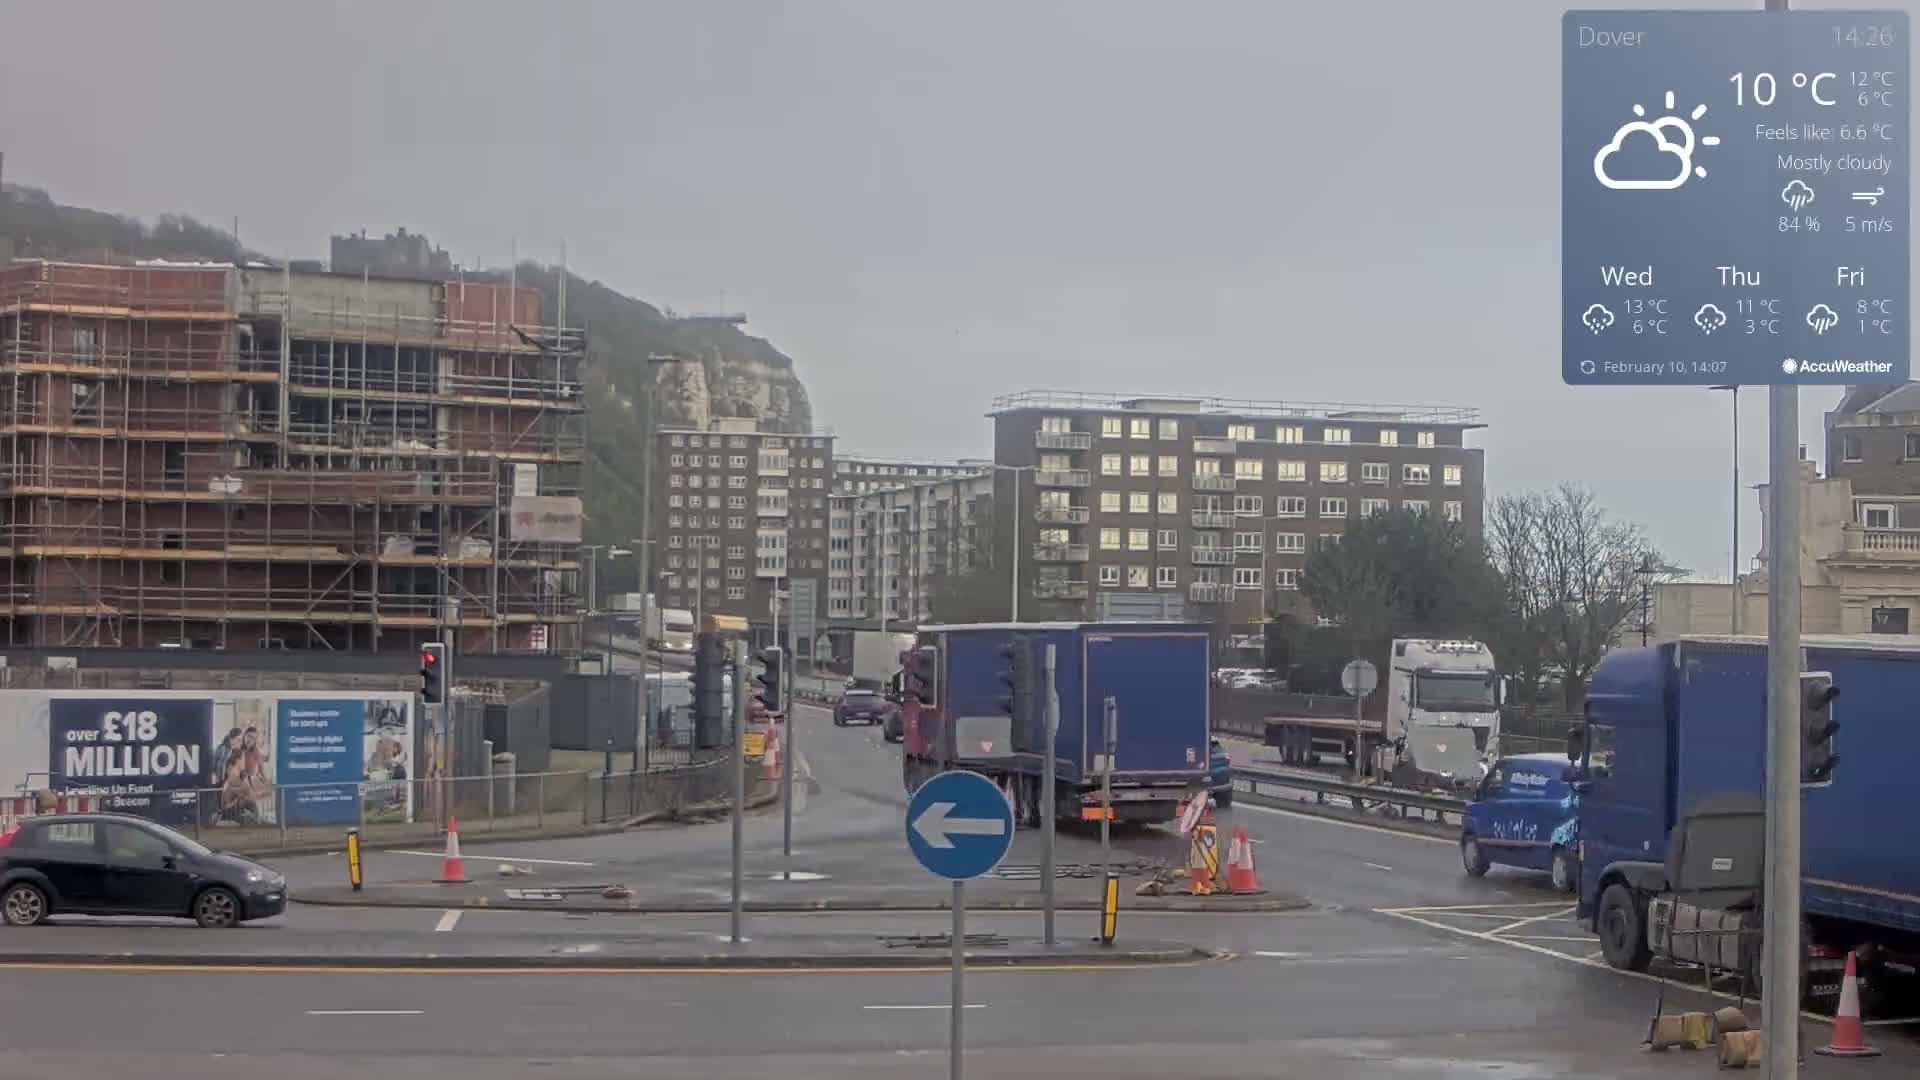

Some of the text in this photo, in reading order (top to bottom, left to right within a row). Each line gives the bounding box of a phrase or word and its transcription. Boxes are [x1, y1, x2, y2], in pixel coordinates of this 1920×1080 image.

[66, 710, 158, 741] over £18
[65, 744, 200, 777] MILLION
[128, 783, 154, 794] Fund
